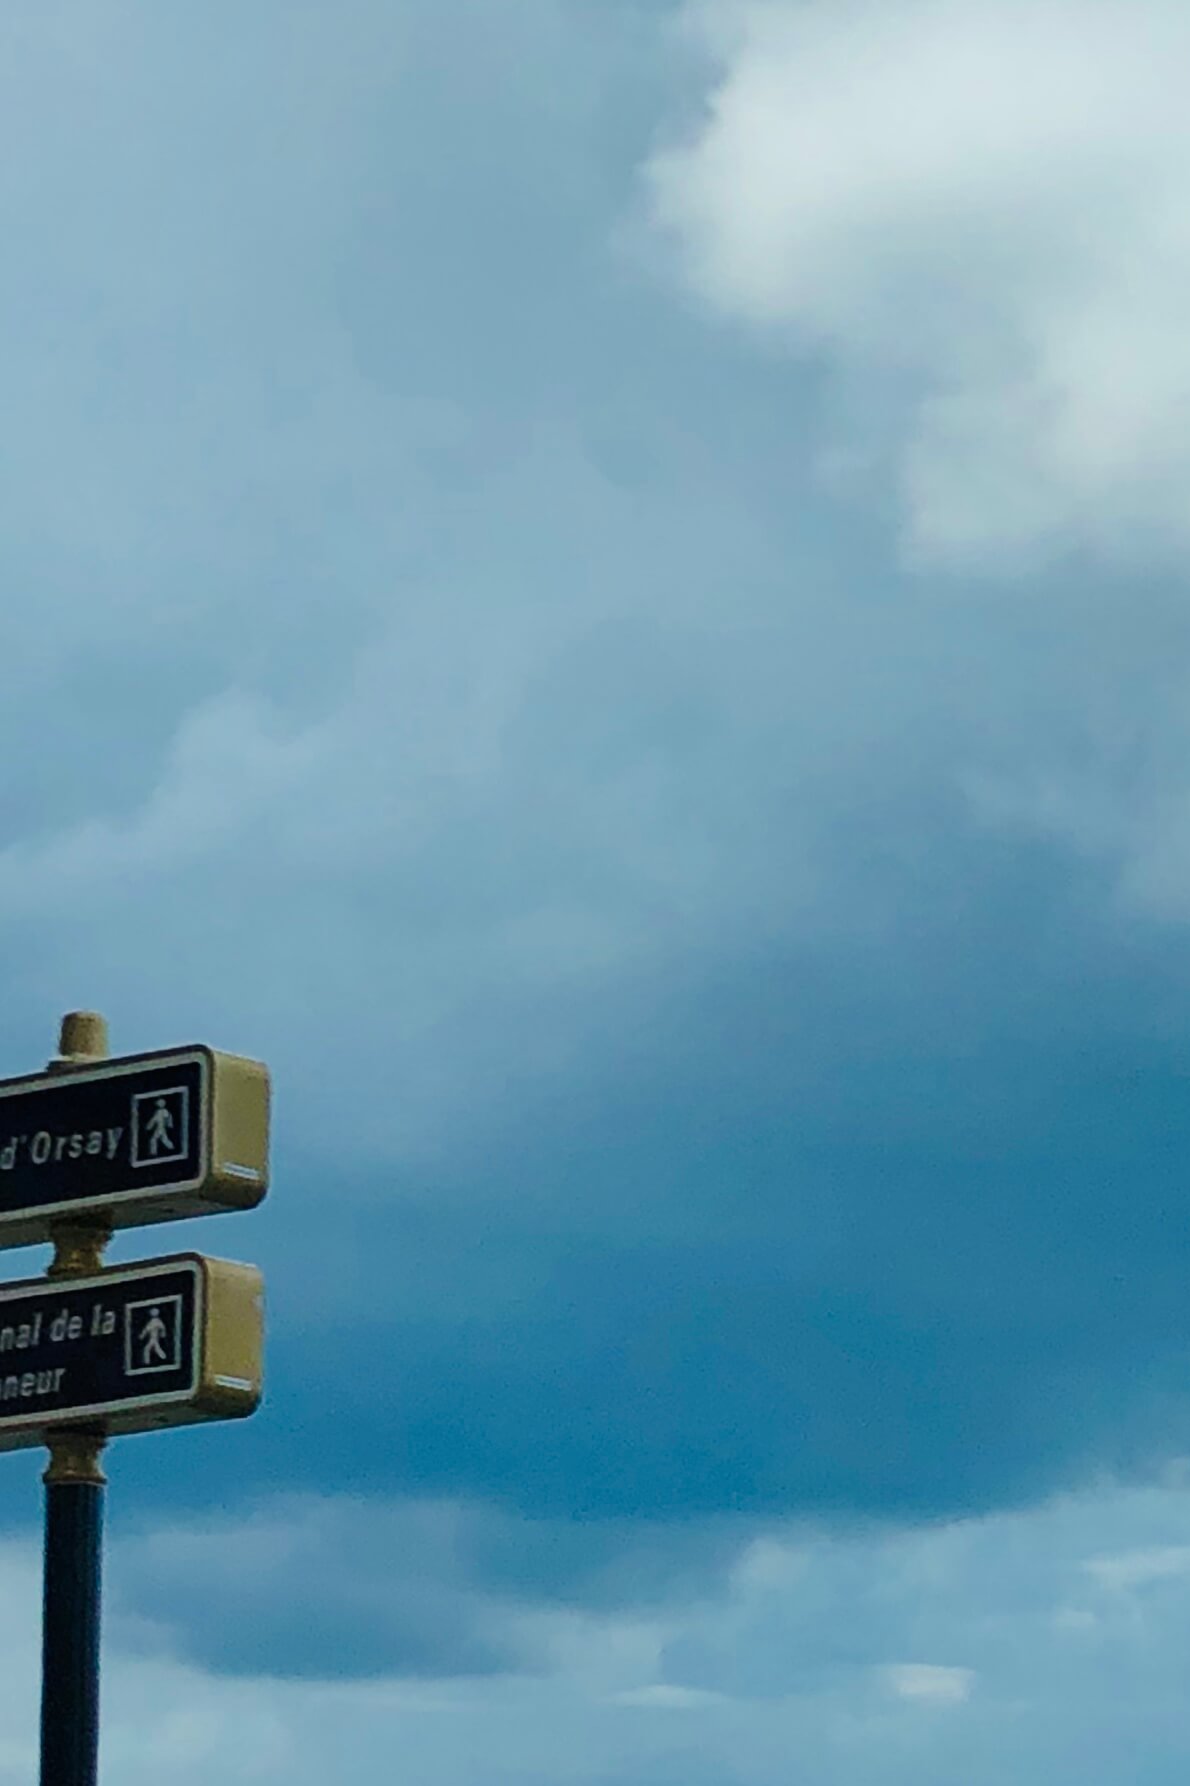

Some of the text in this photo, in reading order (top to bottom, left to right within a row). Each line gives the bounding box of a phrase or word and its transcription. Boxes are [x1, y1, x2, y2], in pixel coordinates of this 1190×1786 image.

[0, 1126, 124, 1170] d'Orsay
[50, 1308, 83, 1342] de
[91, 1304, 116, 1336] la
[0, 1367, 66, 1400] neur
